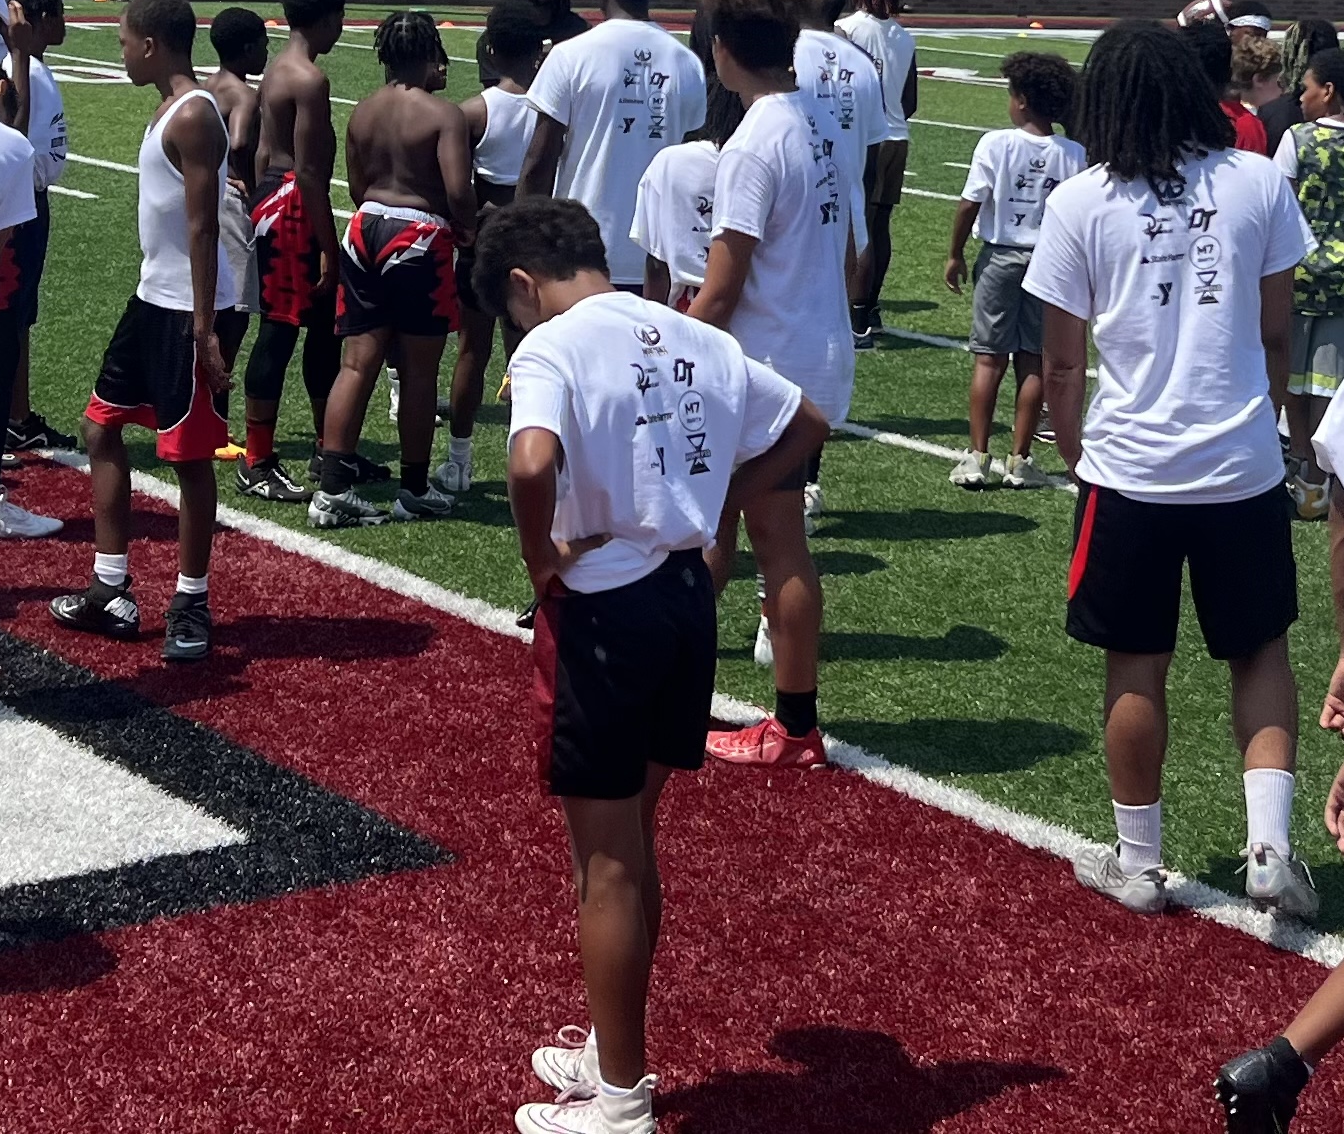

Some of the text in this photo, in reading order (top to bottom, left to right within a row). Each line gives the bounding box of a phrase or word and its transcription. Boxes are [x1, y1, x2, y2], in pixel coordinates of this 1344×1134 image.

[1188, 208, 1217, 232] DT
[1197, 243, 1214, 256] M7
[673, 358, 695, 387] DT
[685, 401, 700, 415] M7
